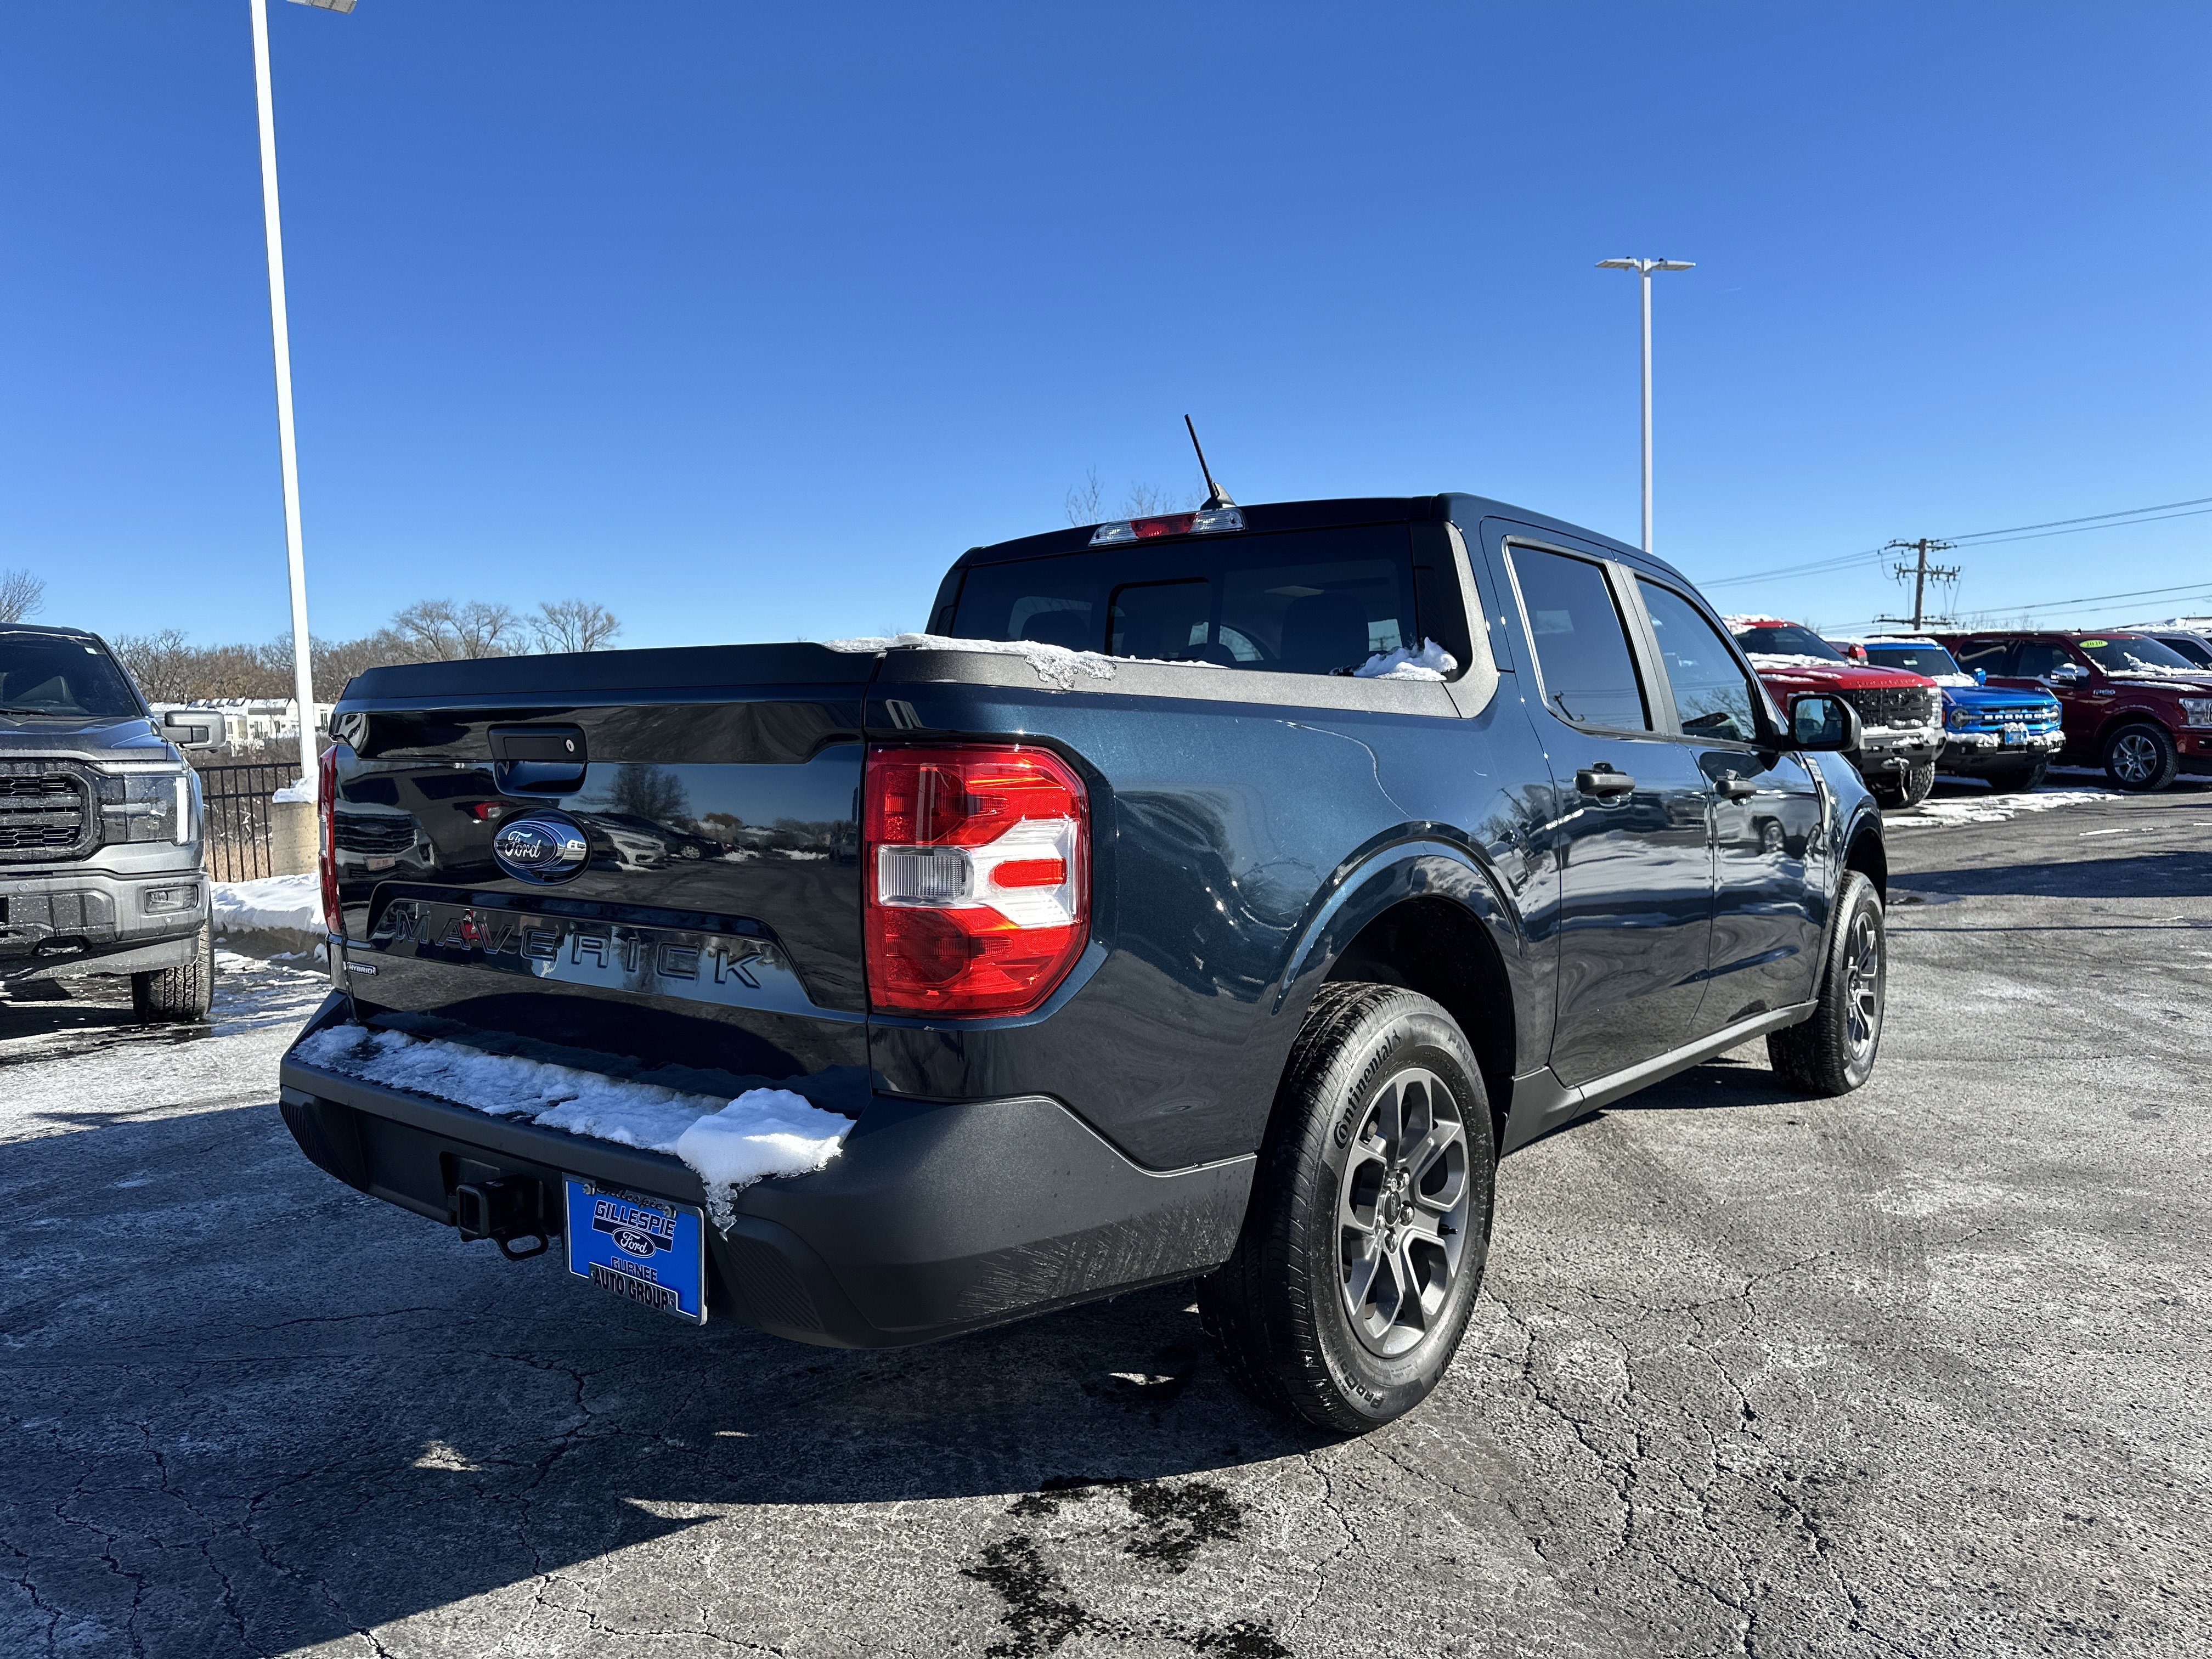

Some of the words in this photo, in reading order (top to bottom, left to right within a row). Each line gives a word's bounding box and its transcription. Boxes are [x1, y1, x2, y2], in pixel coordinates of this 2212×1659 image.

[504, 831, 541, 858] Ford
[396, 909, 761, 989] MAVERICK
[349, 964, 373, 974] HYBRID
[1334, 1035, 1393, 1149] Continental
[593, 1199, 677, 1239] GILLESPIE
[620, 1232, 647, 1254] Ford
[611, 1256, 658, 1283] GURNEE
[594, 1267, 625, 1295] AUTO
[628, 1279, 670, 1311] GROUP
